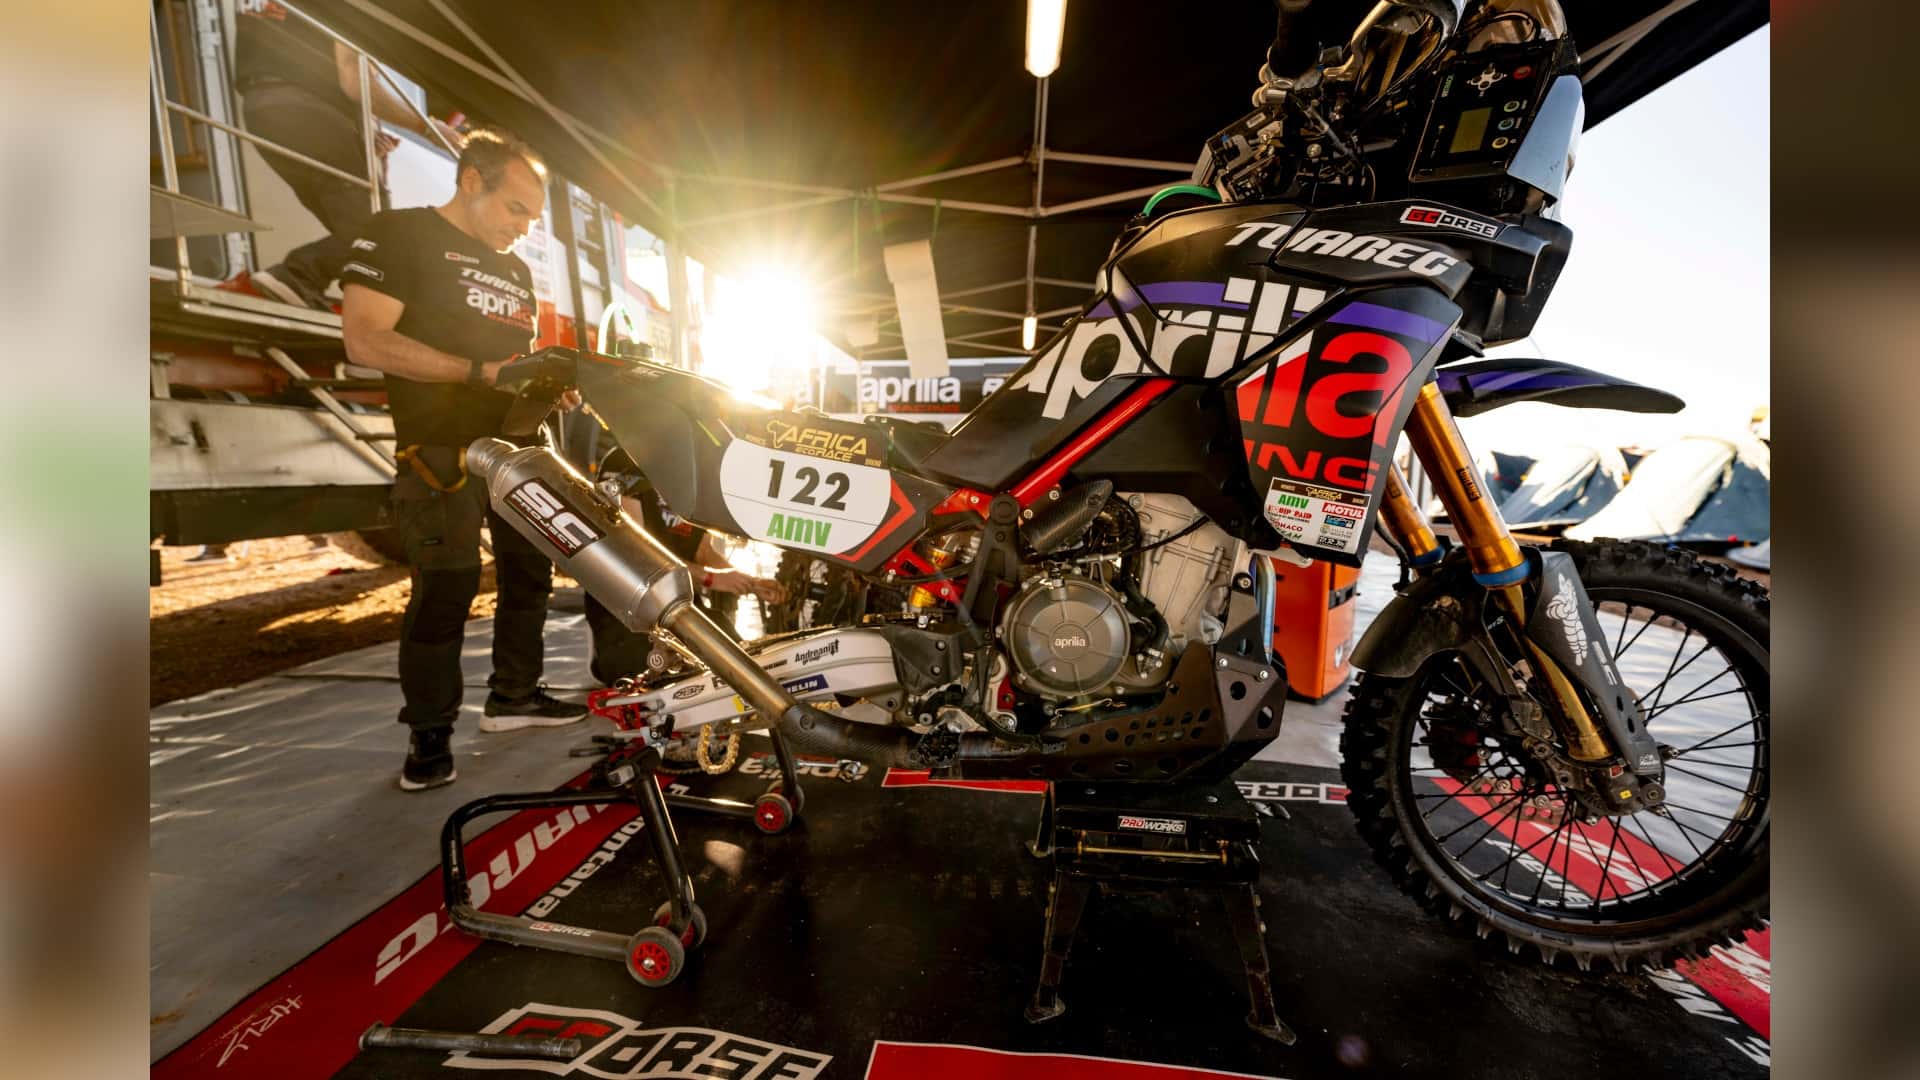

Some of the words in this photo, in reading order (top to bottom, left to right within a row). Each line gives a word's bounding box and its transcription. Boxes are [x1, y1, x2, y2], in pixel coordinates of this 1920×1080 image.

[1404, 209, 1498, 238] GCORSE
[1225, 222, 1461, 277] TUAREG
[860, 376, 960, 409] aprilia
[776, 424, 867, 456] AFRICA
[767, 458, 851, 511] 122
[515, 481, 599, 547] SC
[1278, 494, 1310, 509] AMV
[1323, 503, 1363, 518] MOTUL
[511, 492, 577, 550] PROJECT
[766, 512, 832, 547] AMV
[1053, 633, 1087, 648] aprilia
